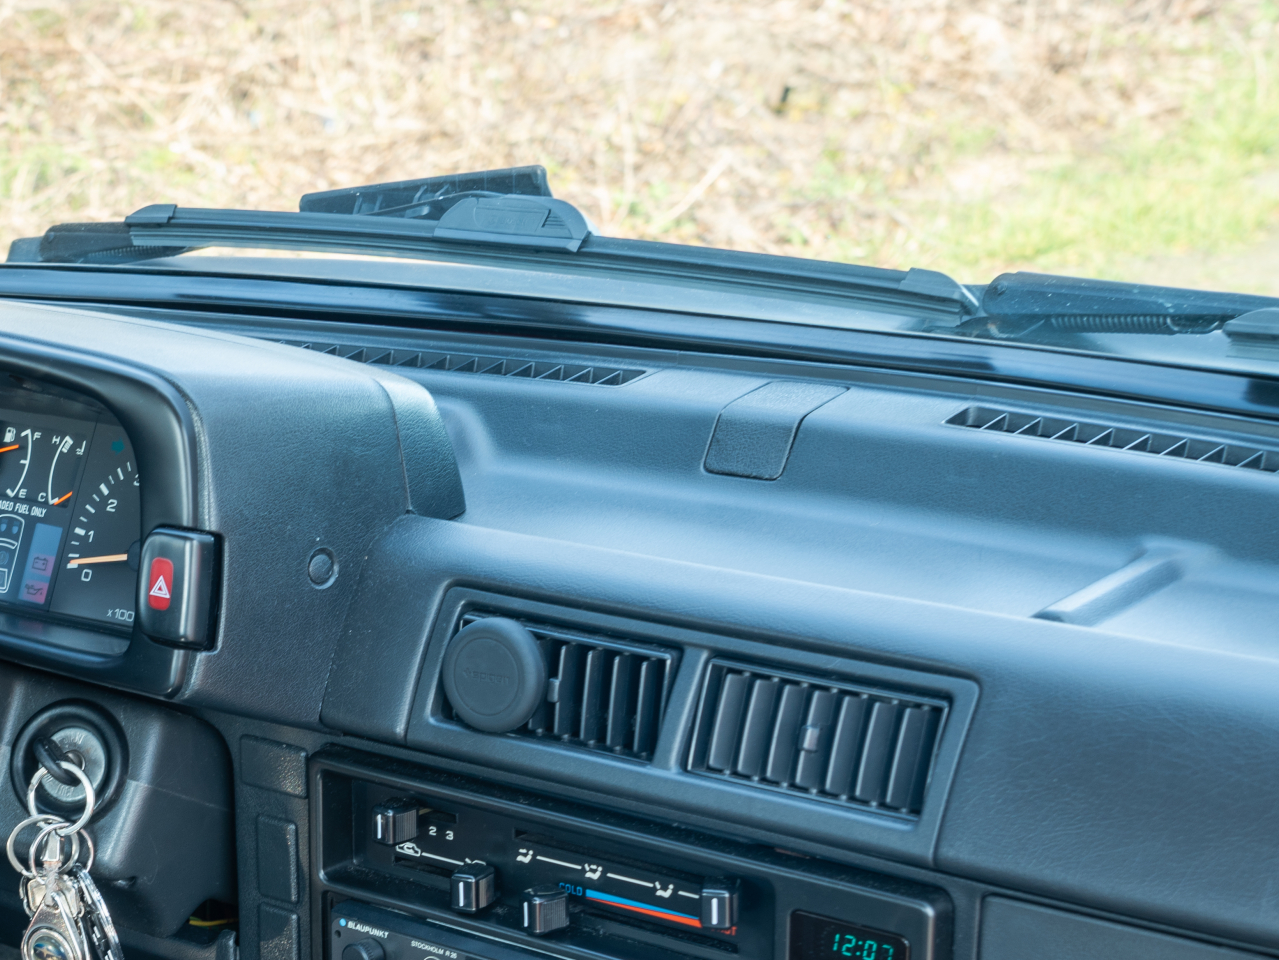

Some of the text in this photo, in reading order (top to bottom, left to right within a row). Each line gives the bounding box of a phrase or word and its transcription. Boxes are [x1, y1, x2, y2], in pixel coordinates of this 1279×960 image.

[33, 432, 42, 441] F
[52, 435, 61, 445] H
[18, 488, 27, 499] E
[38, 492, 47, 502] C
[14, 503, 30, 515] FUEL
[30, 506, 47, 518] ONLY
[106, 499, 118, 512] 2
[88, 530, 95, 543] 1
[81, 569, 92, 581] 0
[428, 826, 437, 836] 2
[445, 830, 454, 840] 3
[347, 921, 389, 939] BLAUPUNKT
[411, 940, 444, 955] STOCKHOLM
